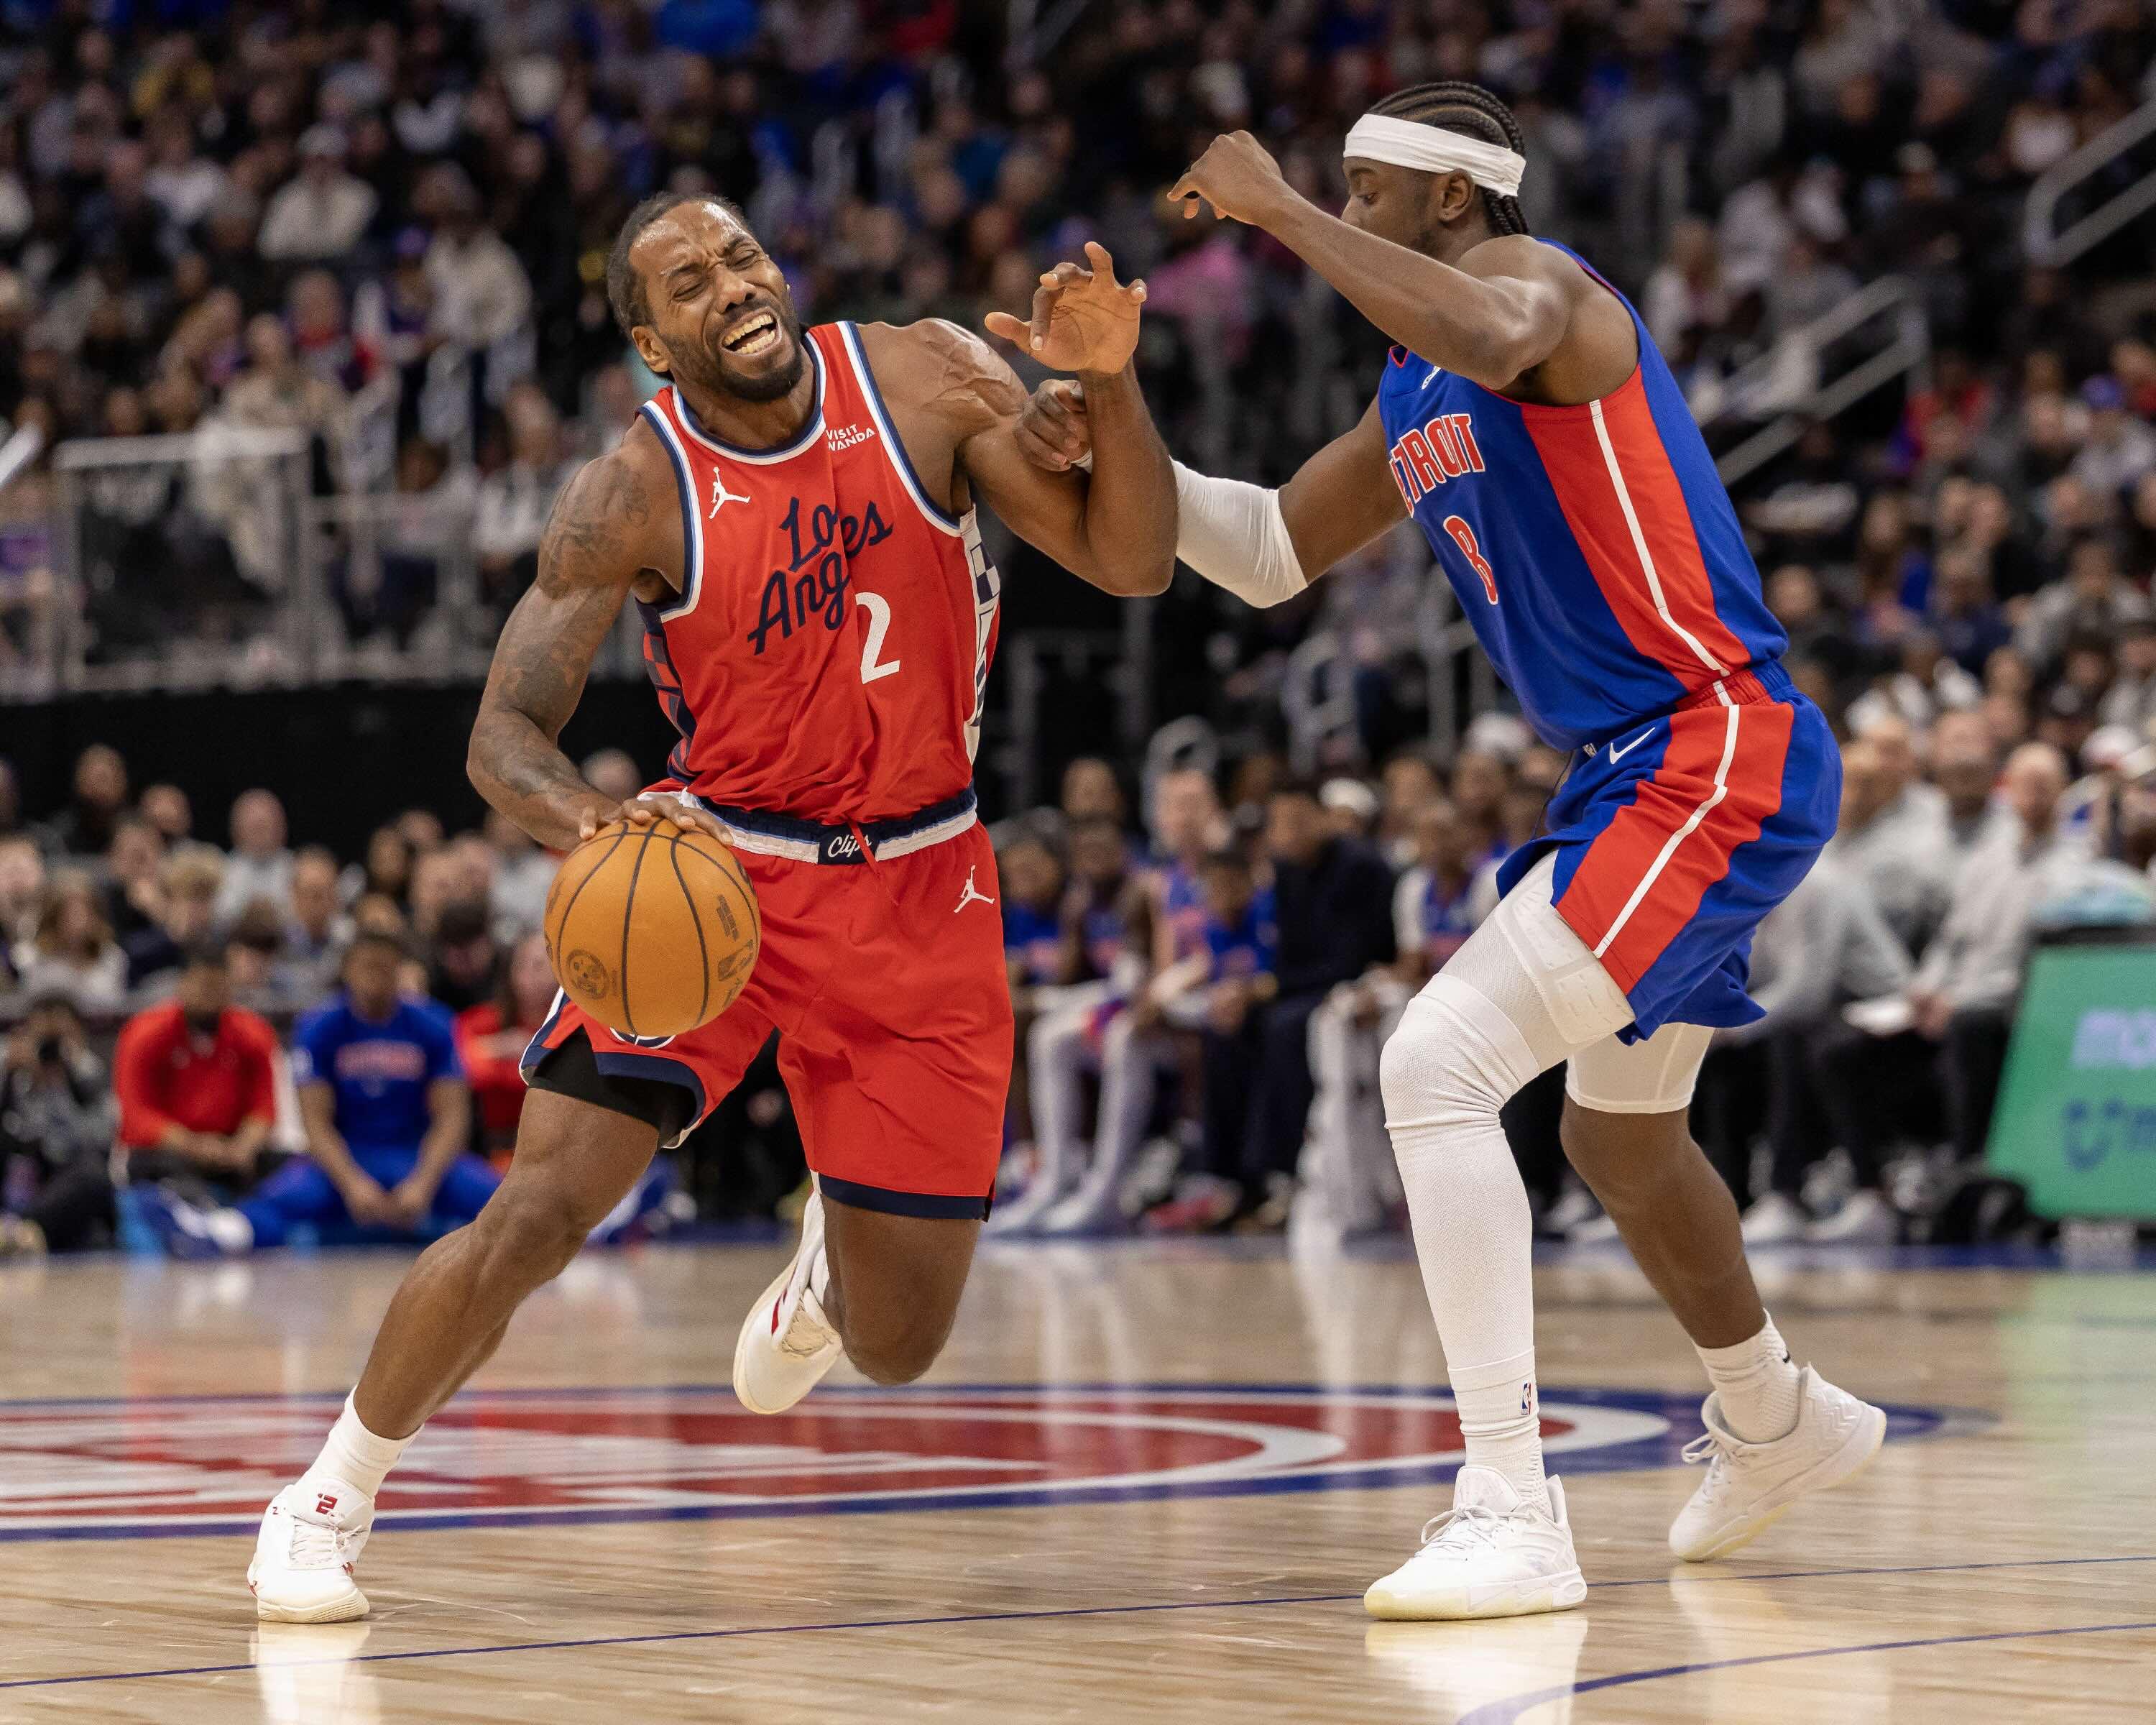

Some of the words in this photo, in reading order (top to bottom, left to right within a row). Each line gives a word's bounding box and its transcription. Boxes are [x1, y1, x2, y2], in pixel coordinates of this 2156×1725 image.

[825, 423, 857, 441] VISIT
[1442, 515, 1498, 605] 8
[855, 592, 900, 685] 2
